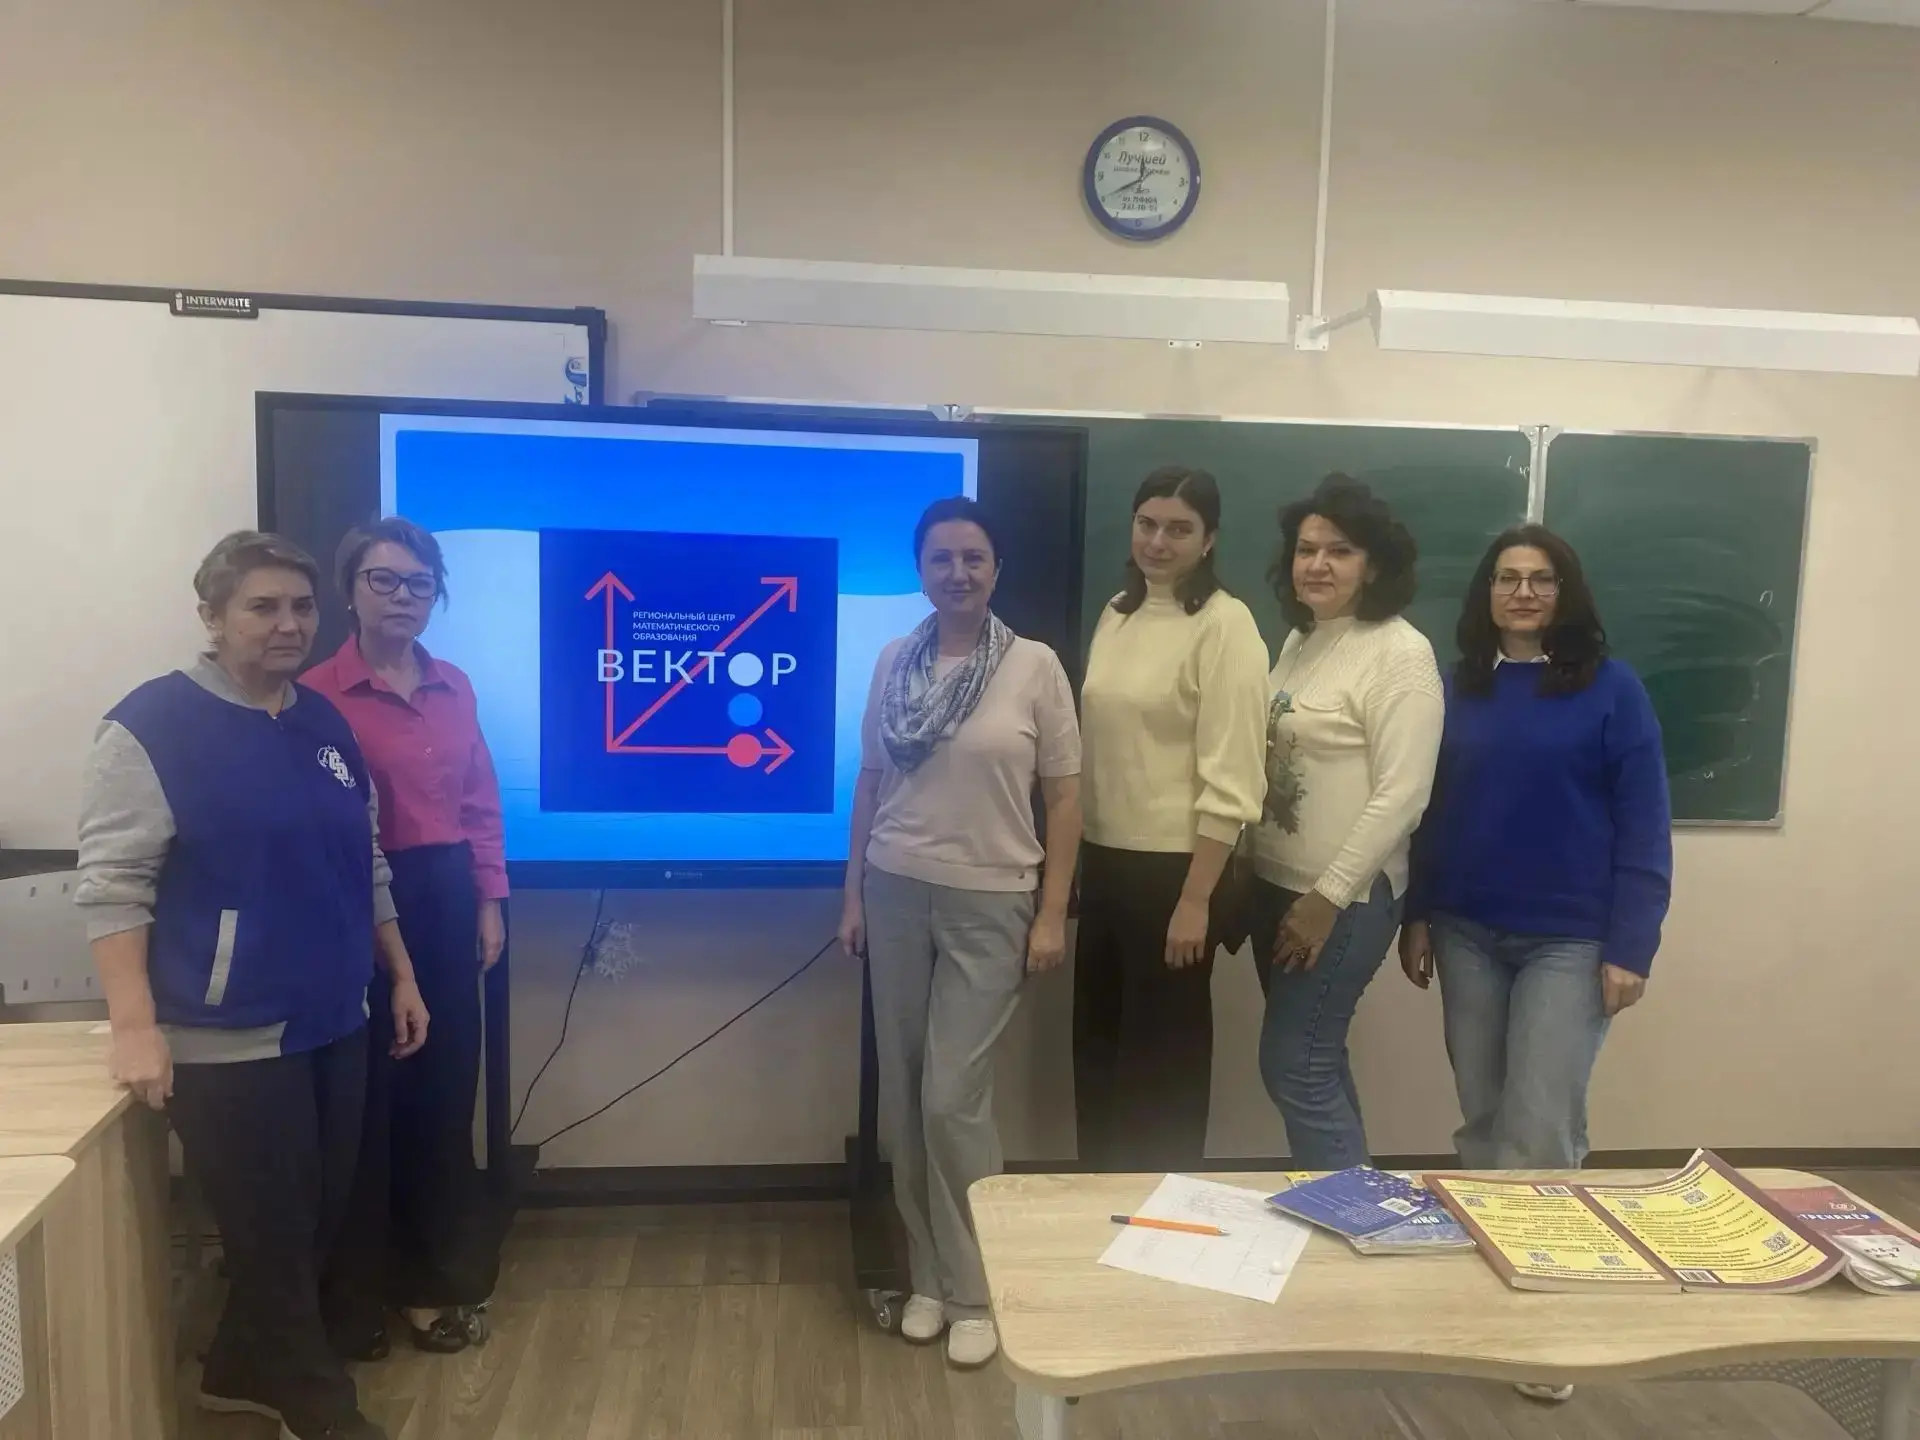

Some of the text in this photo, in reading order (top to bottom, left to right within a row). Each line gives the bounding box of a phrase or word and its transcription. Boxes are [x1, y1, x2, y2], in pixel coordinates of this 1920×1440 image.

[1139, 132, 1149, 142] 12
[1118, 151, 1167, 165] Лучшей
[186, 296, 251, 308] INTERWRITE
[633, 611, 736, 622] РЕГИОНАЛЬНЫЙ ЦЕНТР
[633, 622, 720, 632] МАТЕМАТИЧЕСКОГО
[633, 633, 697, 642] ОБРАЗОВАНИЯ
[597, 649, 797, 687] ВЕКТОР
